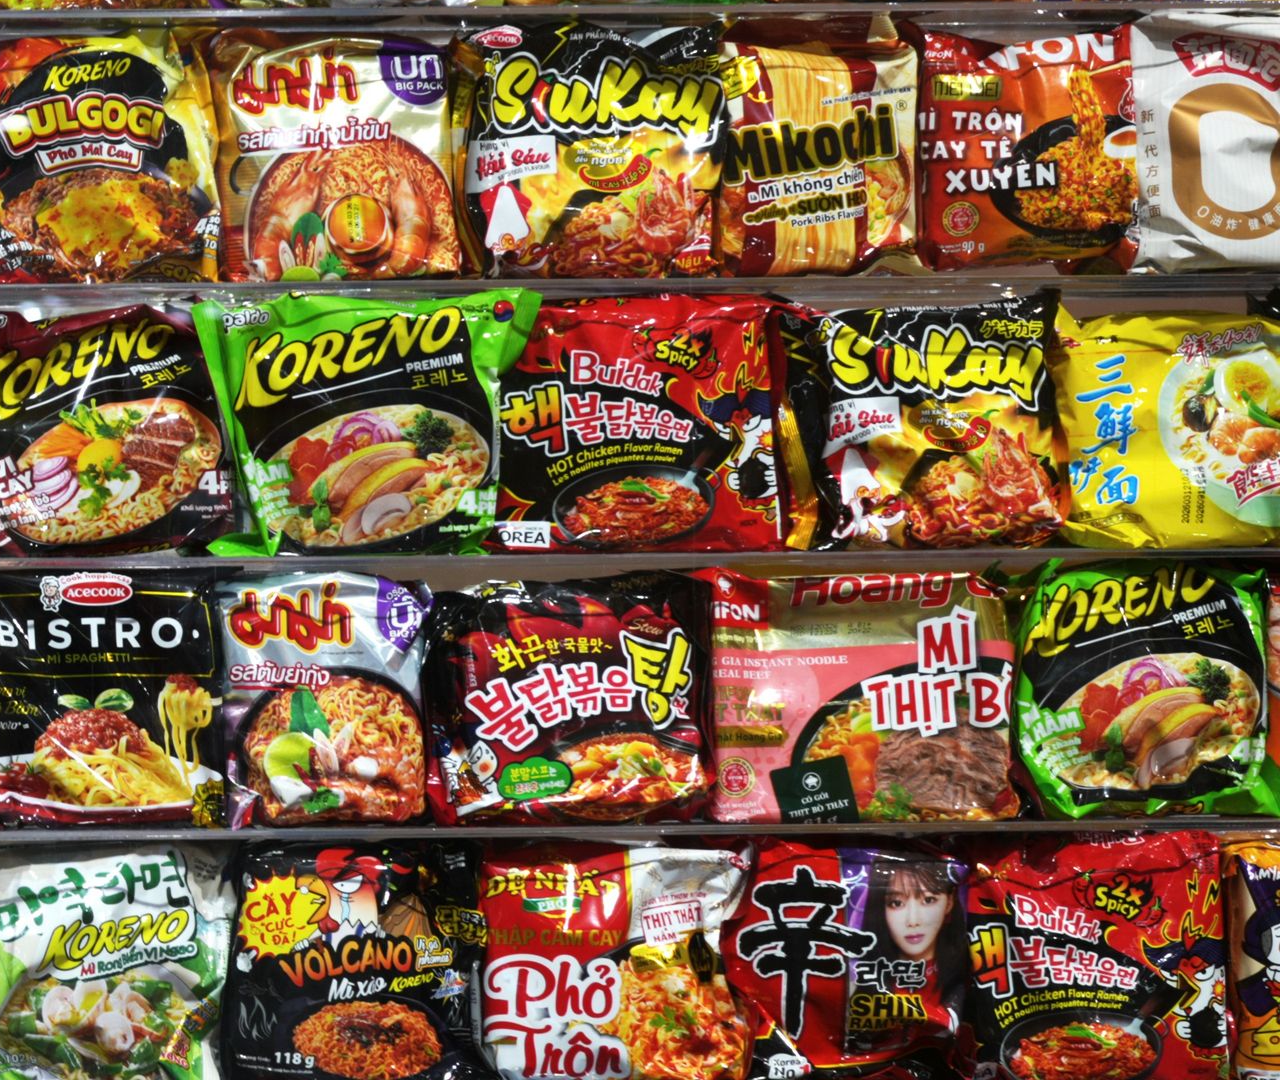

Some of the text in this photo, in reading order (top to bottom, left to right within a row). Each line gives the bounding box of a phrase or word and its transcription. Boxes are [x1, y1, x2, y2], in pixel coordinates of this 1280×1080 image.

[45, 58, 129, 90] KORENO
[396, 81, 443, 90] BIG PACK
[0, 96, 163, 152] BULGOGI
[406, 353, 463, 372] PREMIUM
[656, 343, 696, 369] Spicy
[547, 443, 652, 477] HOT Chicken Flavor
[1175, 600, 1226, 623] PREMIUM
[47, 653, 130, 663] MÌ SPAGHETTI
[864, 675, 961, 736] THỊT
[46, 910, 189, 971] KORENO
[280, 939, 411, 985] VOLCANO
[488, 957, 619, 1021] Phở
[274, 1053, 300, 1064] 118
